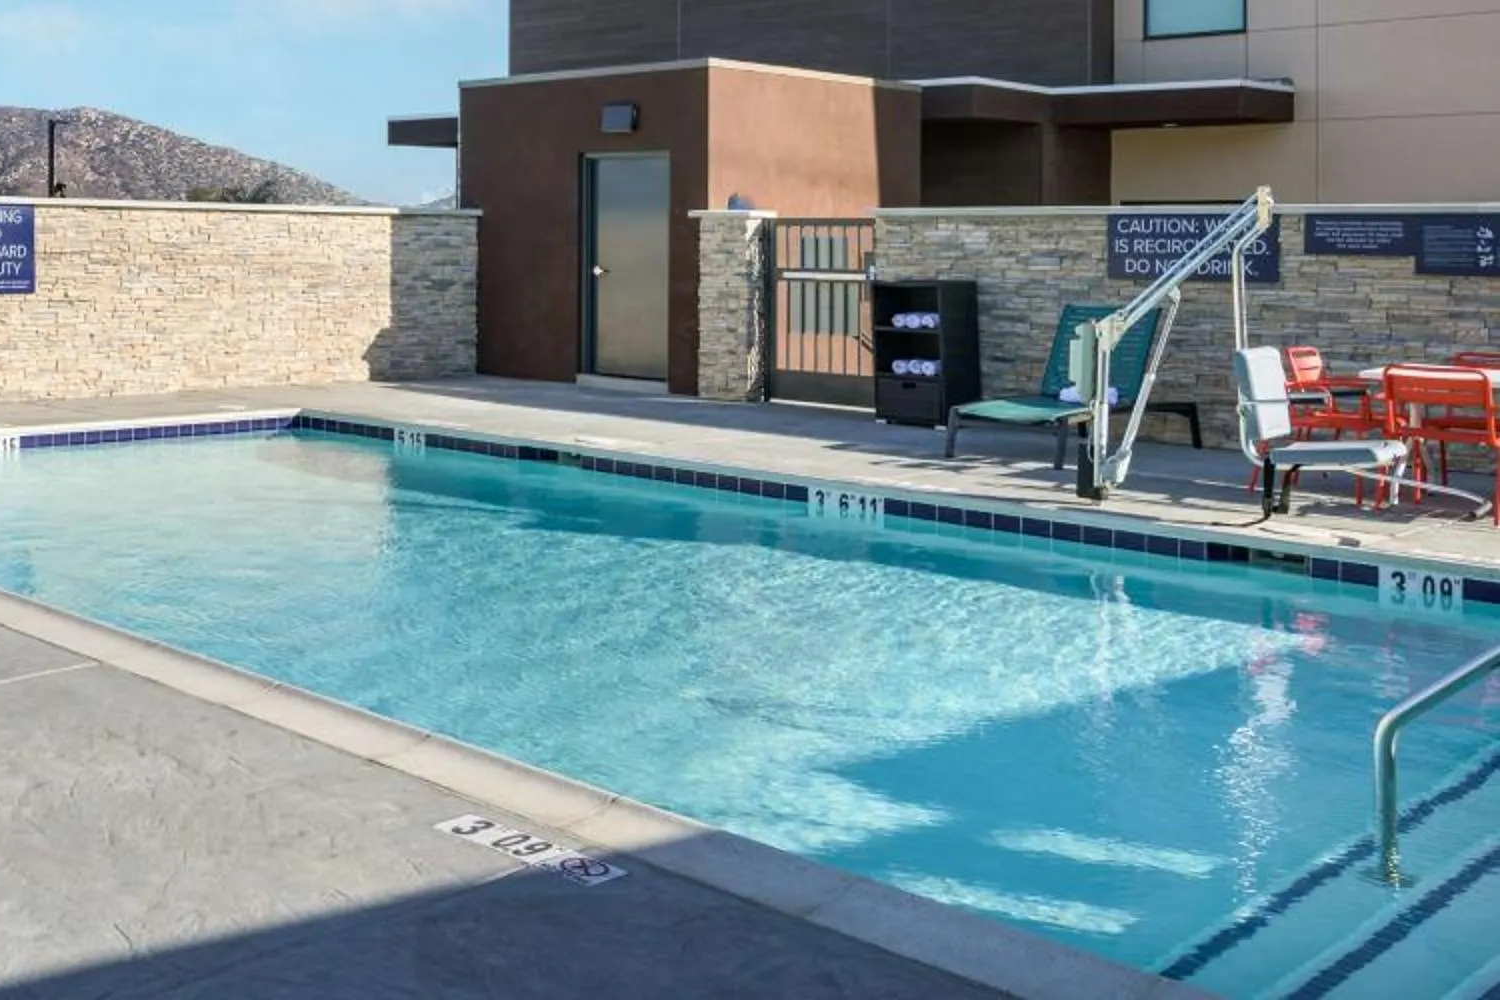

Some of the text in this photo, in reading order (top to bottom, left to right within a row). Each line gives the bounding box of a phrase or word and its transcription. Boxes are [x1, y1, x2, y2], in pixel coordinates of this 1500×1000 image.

[1117, 218, 1200, 234] CAUTION:
[1115, 239, 1129, 253] IS
[1125, 259, 1150, 273] DO
